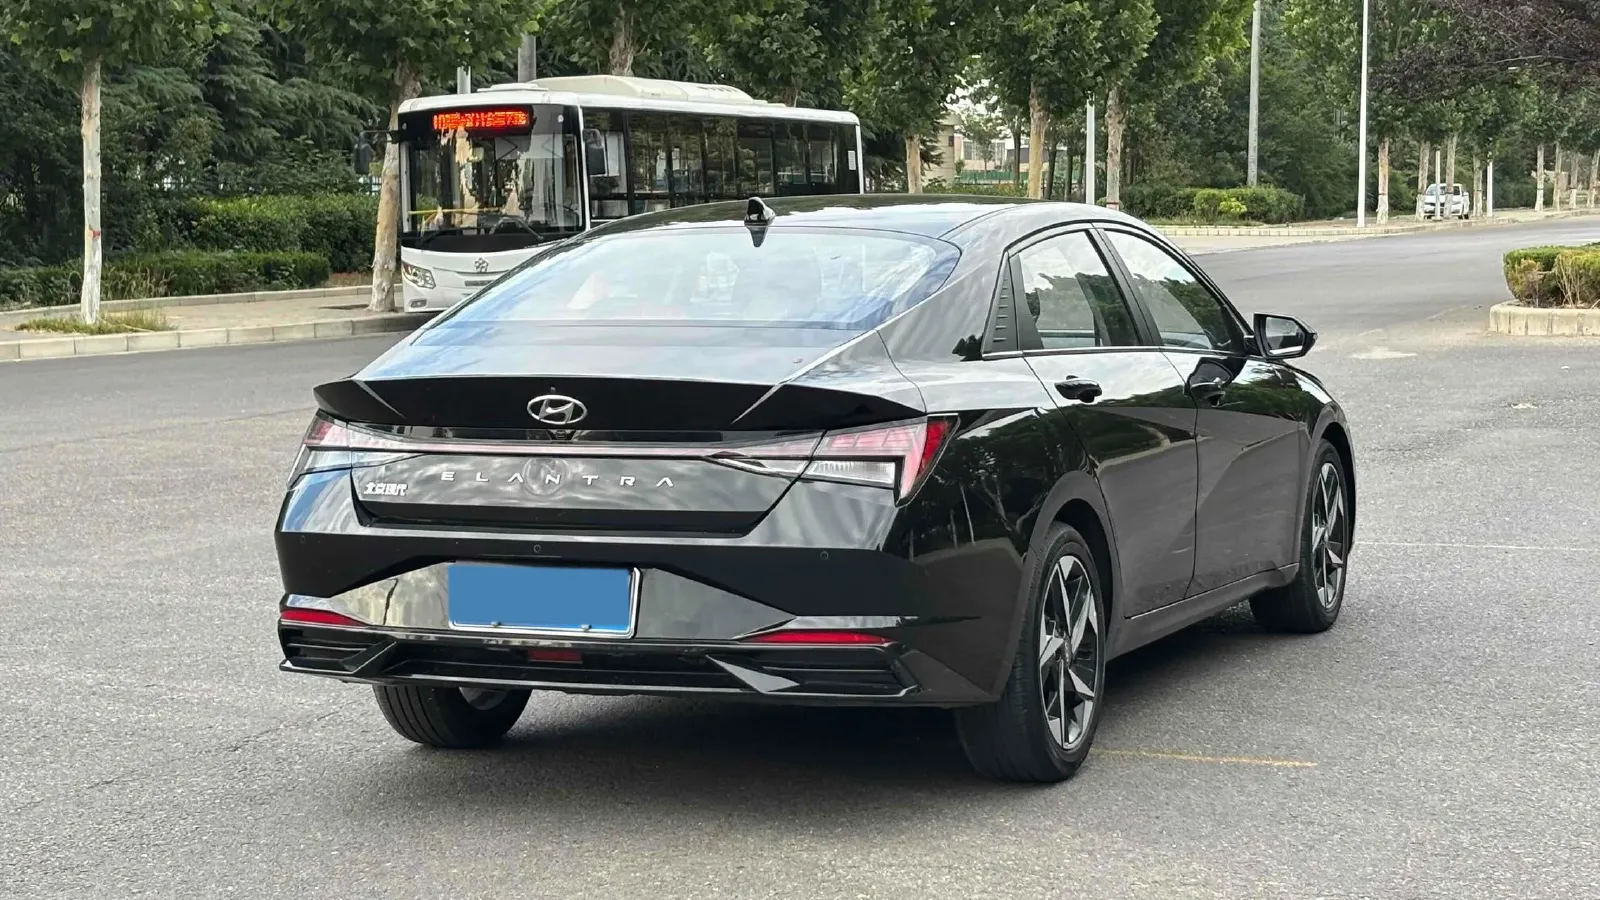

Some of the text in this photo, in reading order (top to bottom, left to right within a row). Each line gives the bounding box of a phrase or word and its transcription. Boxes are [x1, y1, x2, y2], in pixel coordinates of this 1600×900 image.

[441, 471, 674, 487] ELANTRA
[363, 482, 408, 497] 北京现代
